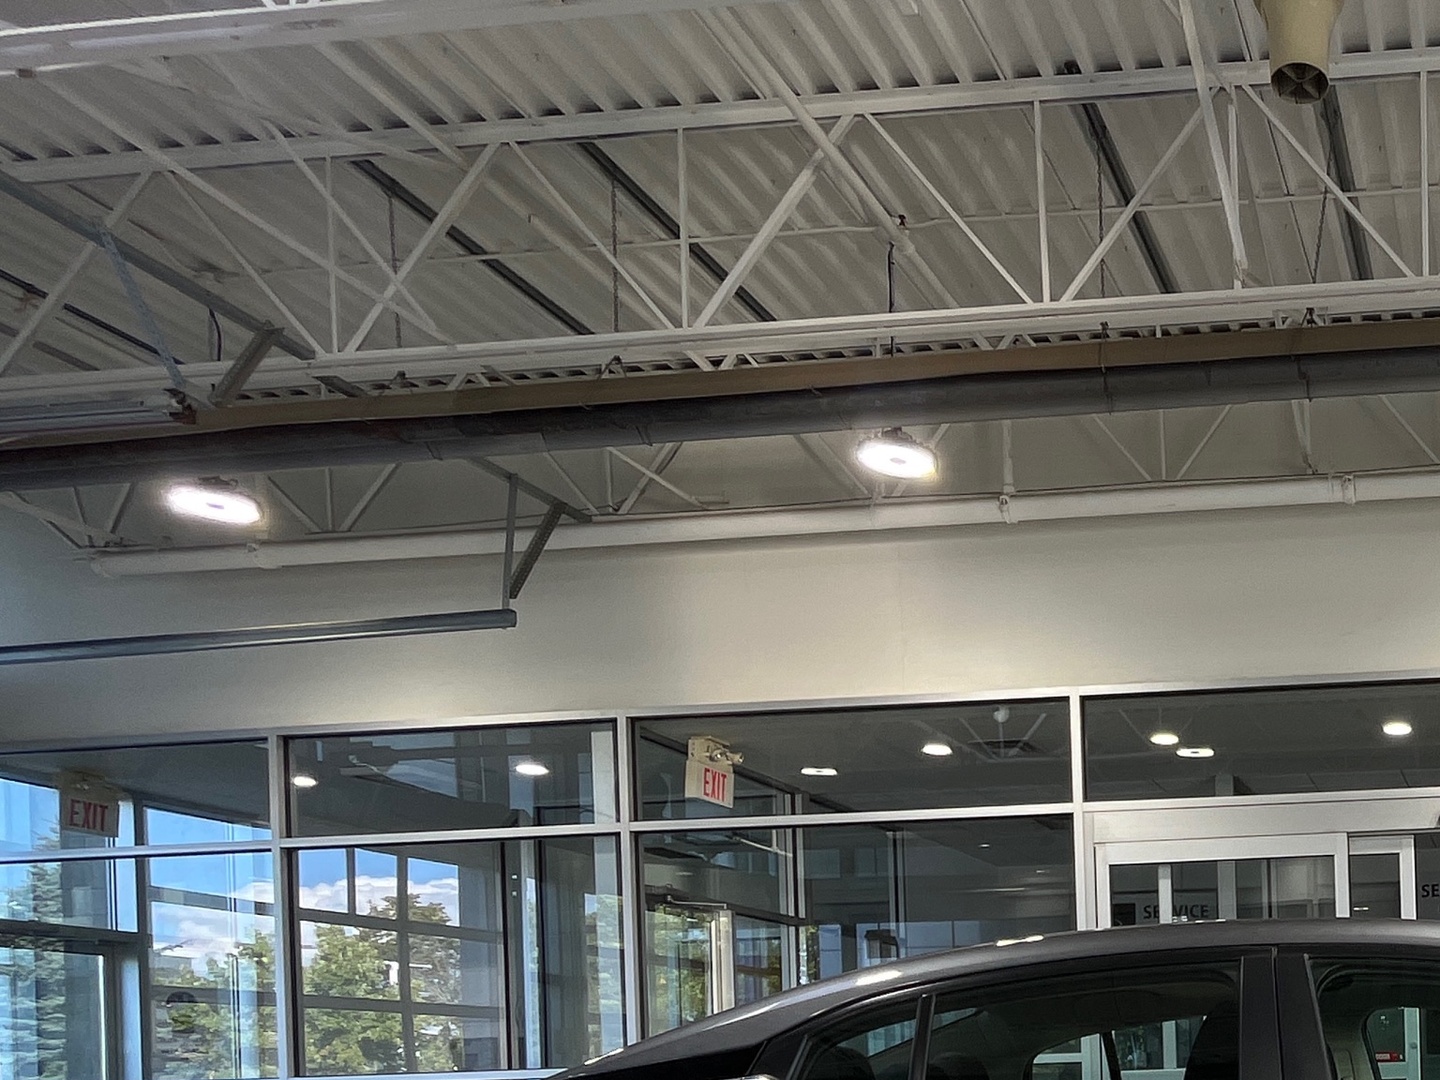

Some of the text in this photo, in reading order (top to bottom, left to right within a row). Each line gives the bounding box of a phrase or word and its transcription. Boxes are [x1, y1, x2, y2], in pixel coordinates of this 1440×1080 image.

[703, 767, 727, 802] EXIT
[69, 798, 108, 832] EXIT
[1143, 903, 1210, 919] SEVICE
